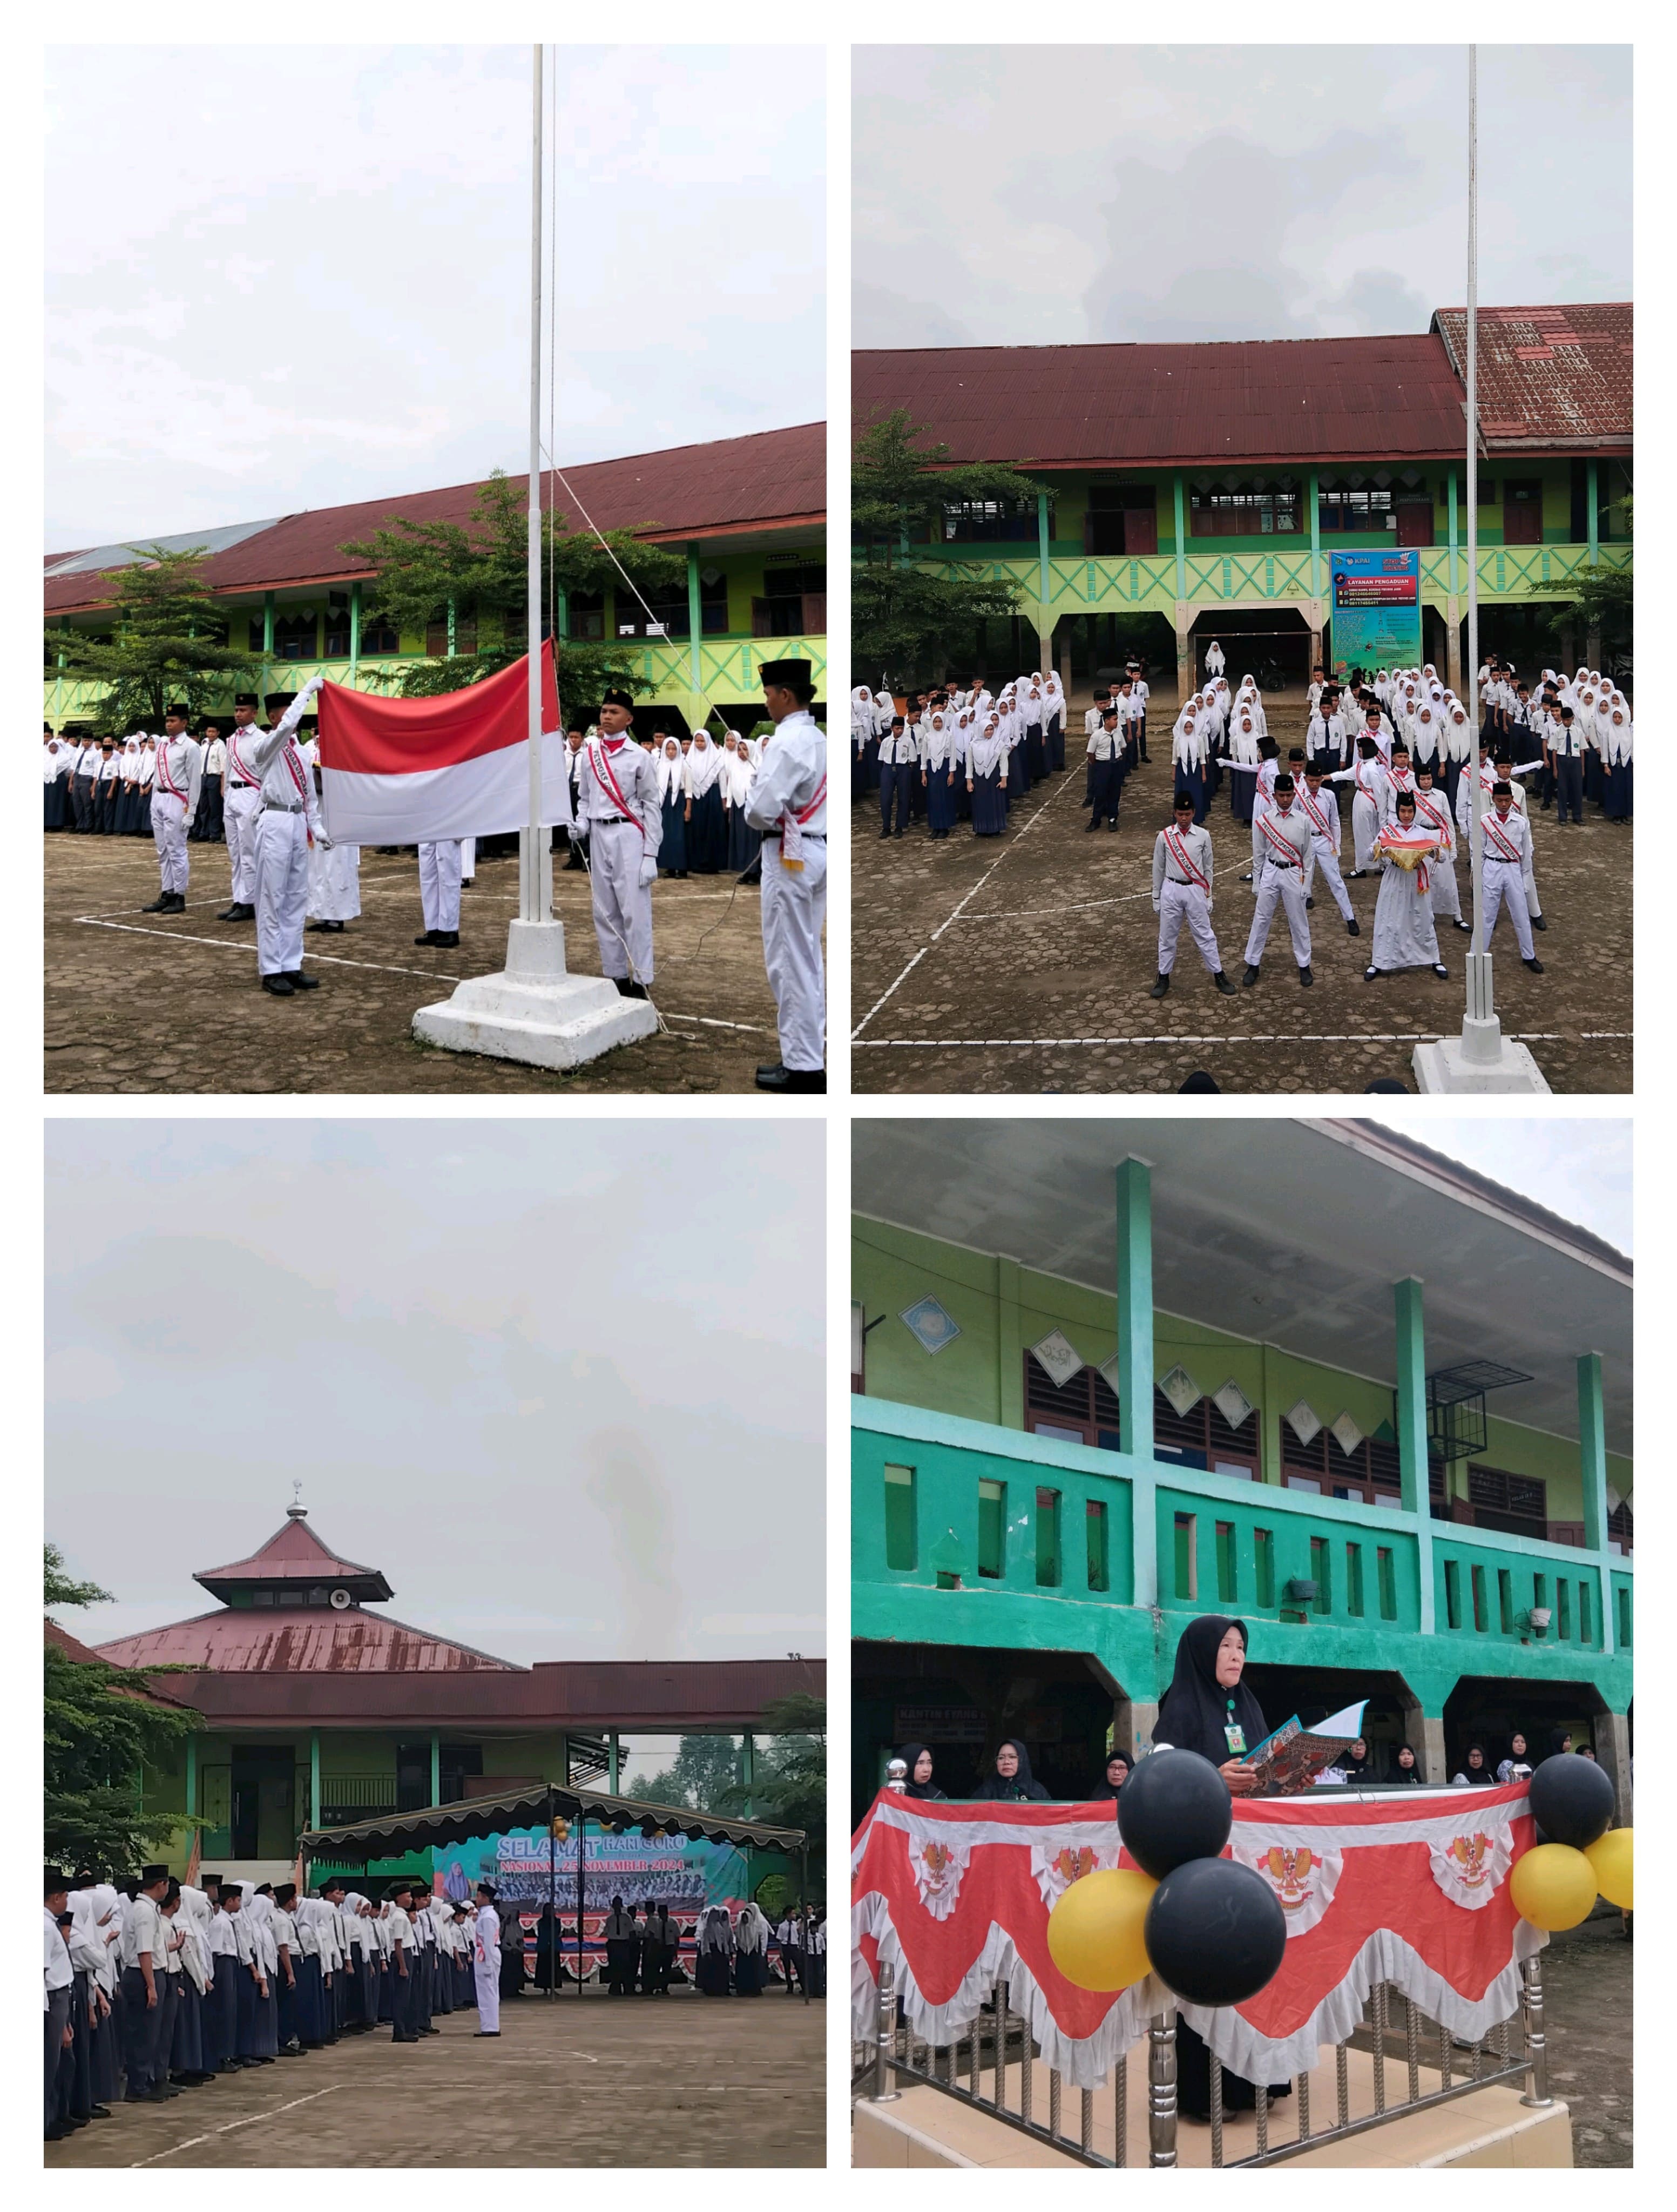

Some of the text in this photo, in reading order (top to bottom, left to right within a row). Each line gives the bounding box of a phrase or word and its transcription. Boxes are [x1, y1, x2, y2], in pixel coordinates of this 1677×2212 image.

[593, 750, 608, 781] PETUGAS
[1168, 831, 1194, 874] PETUGAS UPACARA
[1262, 822, 1296, 858] PETUGAS UPACARA
[1492, 831, 1510, 851] PETUGAS
[496, 1836, 601, 1861] SELAMAT
[603, 1835, 639, 1851] HARI
[562, 1861, 578, 1872] 25
[584, 1859, 648, 1873] NOVEMBER
[651, 1859, 685, 1871] 2024
